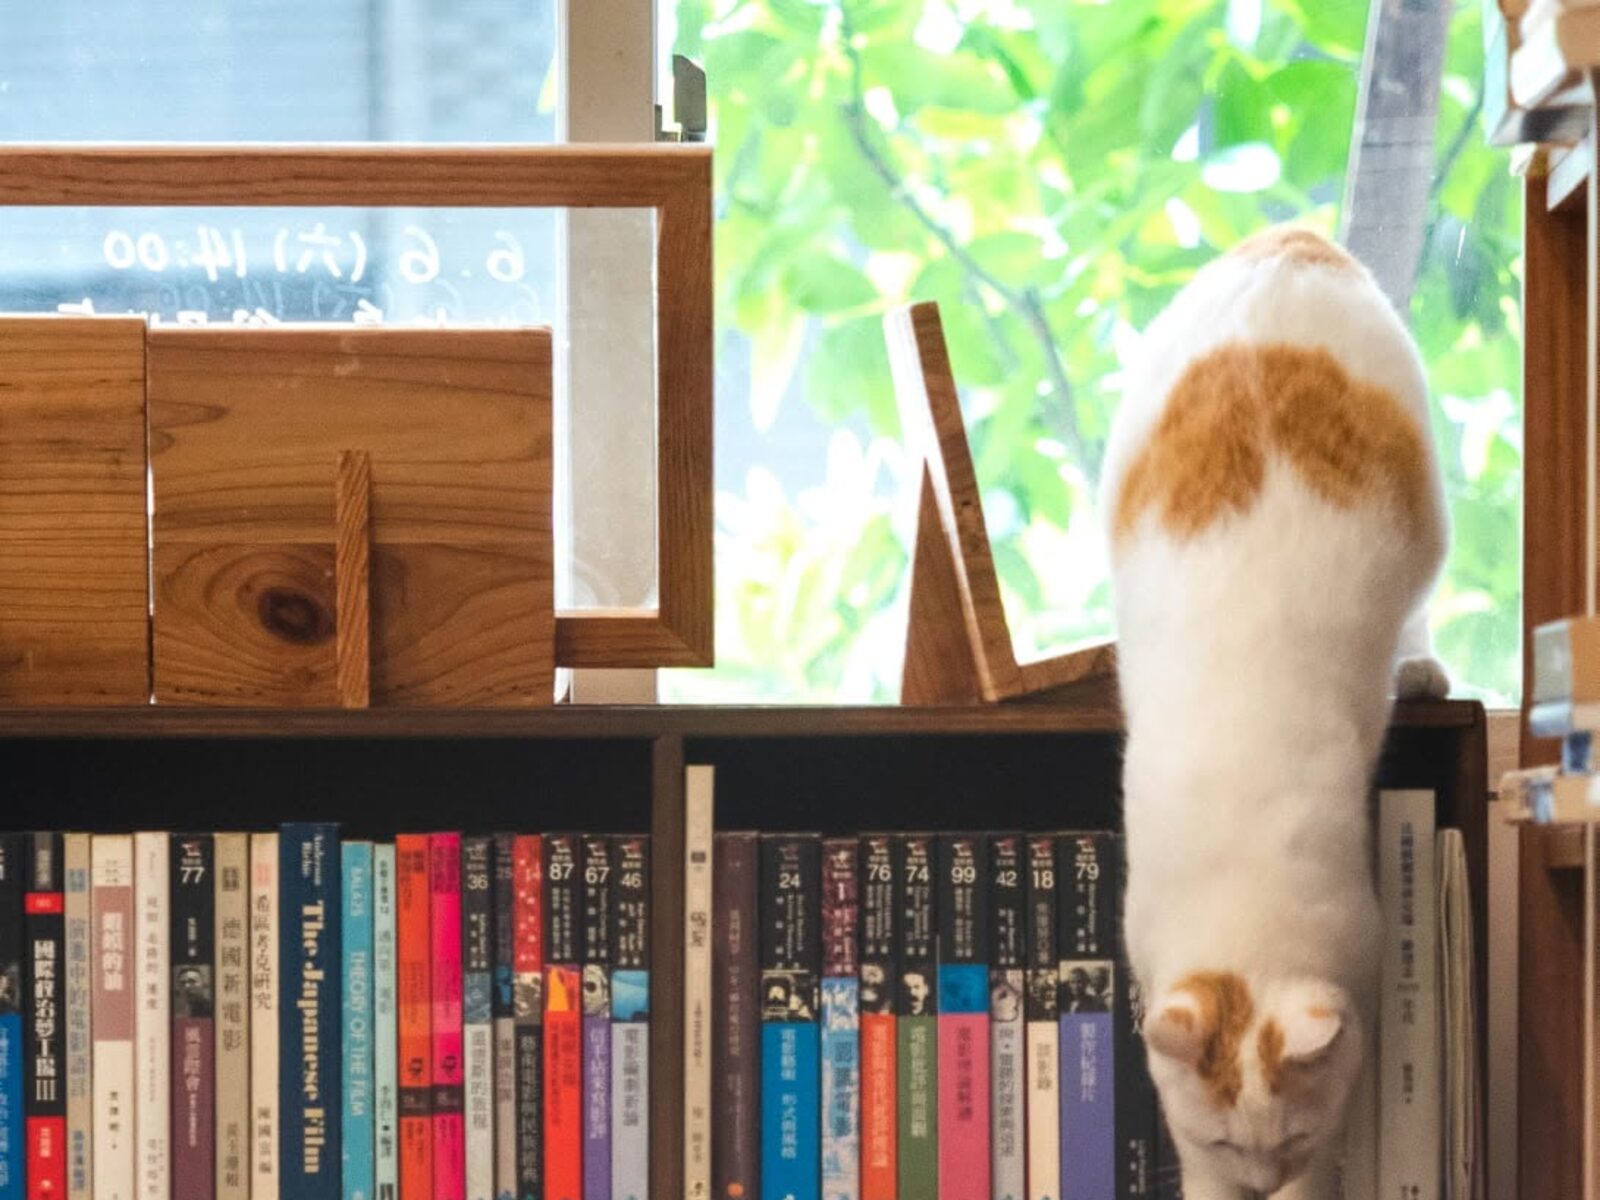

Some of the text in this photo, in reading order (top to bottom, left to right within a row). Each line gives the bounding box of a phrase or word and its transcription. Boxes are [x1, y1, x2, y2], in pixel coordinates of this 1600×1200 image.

[180, 866, 205, 884] 77
[550, 863, 574, 881] 87
[585, 867, 609, 884] 67
[621, 872, 642, 888] 46
[868, 864, 891, 882] 76
[906, 866, 929, 883] 74
[951, 867, 976, 884] 99
[995, 871, 1017, 887] 42
[1032, 871, 1055, 889] 18
[1075, 863, 1099, 881] 79
[467, 873, 488, 890] 36
[779, 873, 800, 890] 24
[297, 900, 325, 1174] The Japanese Film
[350, 951, 366, 1117] THEORY OF THE FILM
